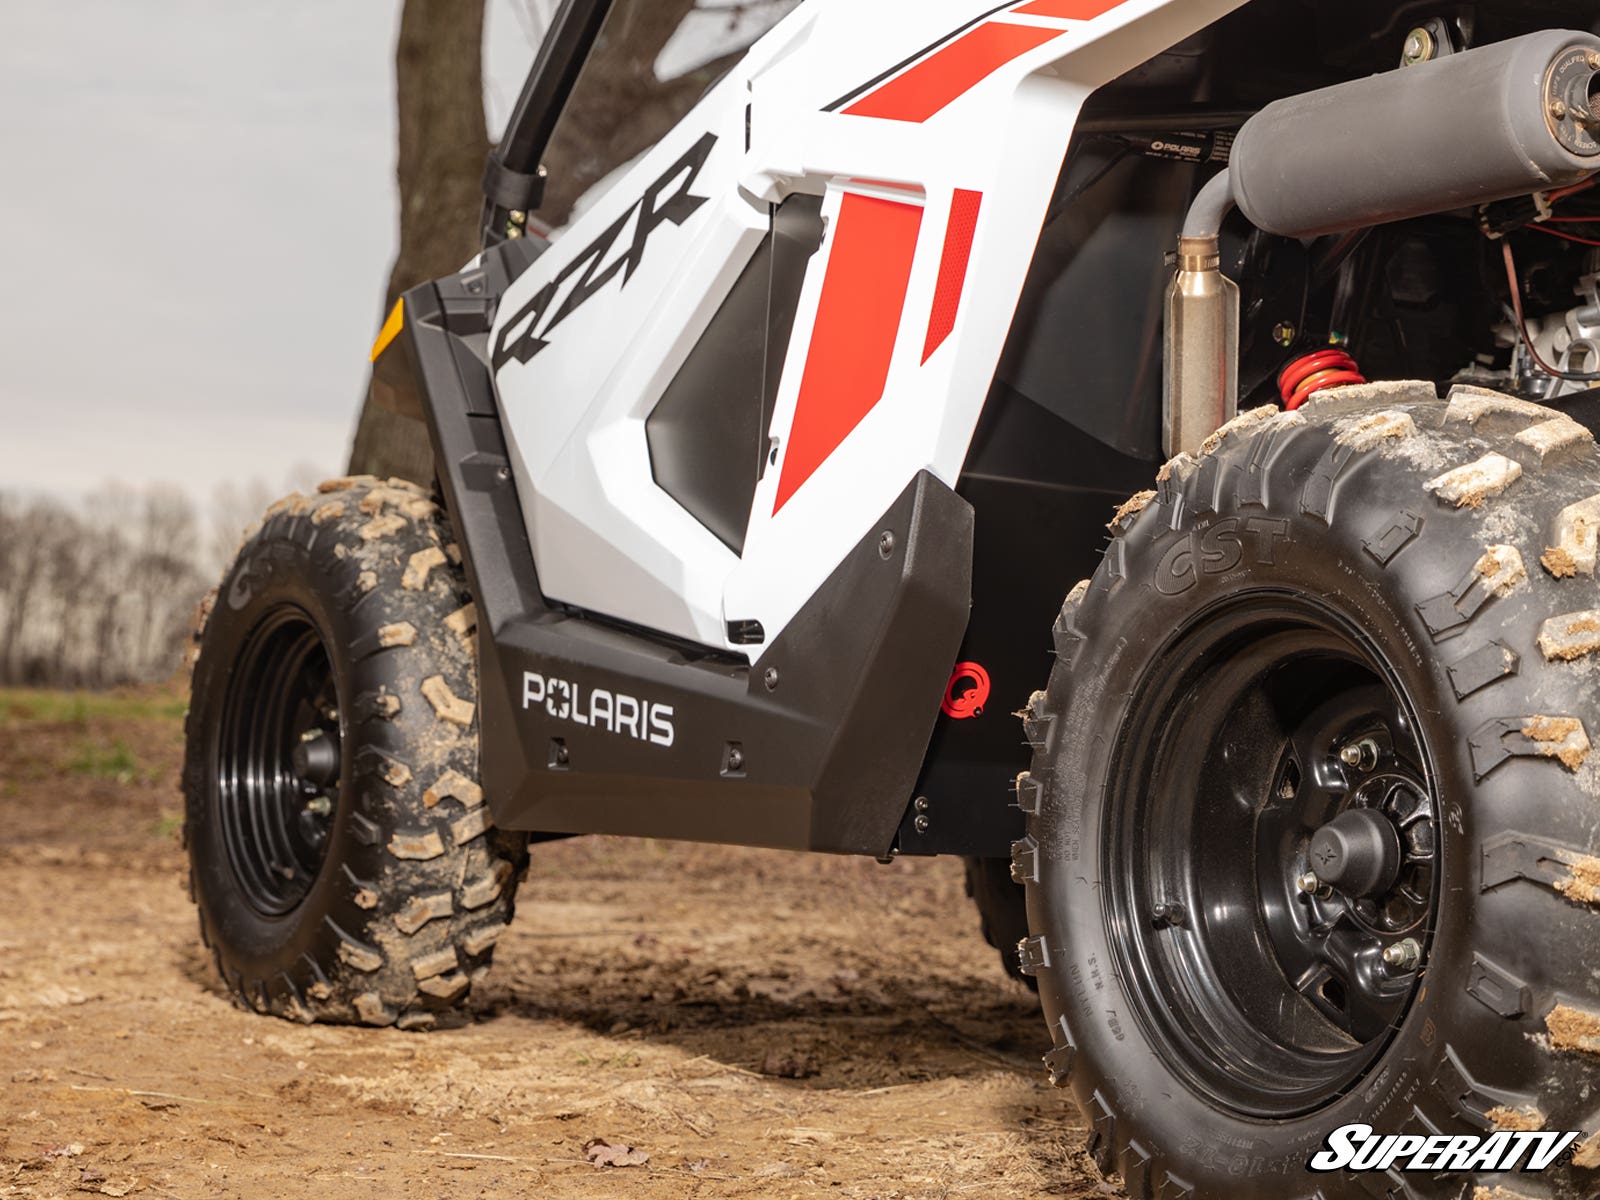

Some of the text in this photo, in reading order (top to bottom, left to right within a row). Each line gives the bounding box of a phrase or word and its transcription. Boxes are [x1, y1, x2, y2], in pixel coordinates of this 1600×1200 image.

[1163, 143, 1201, 154] POLARIS
[491, 131, 719, 373] RZR
[522, 671, 675, 747] POLARIS
